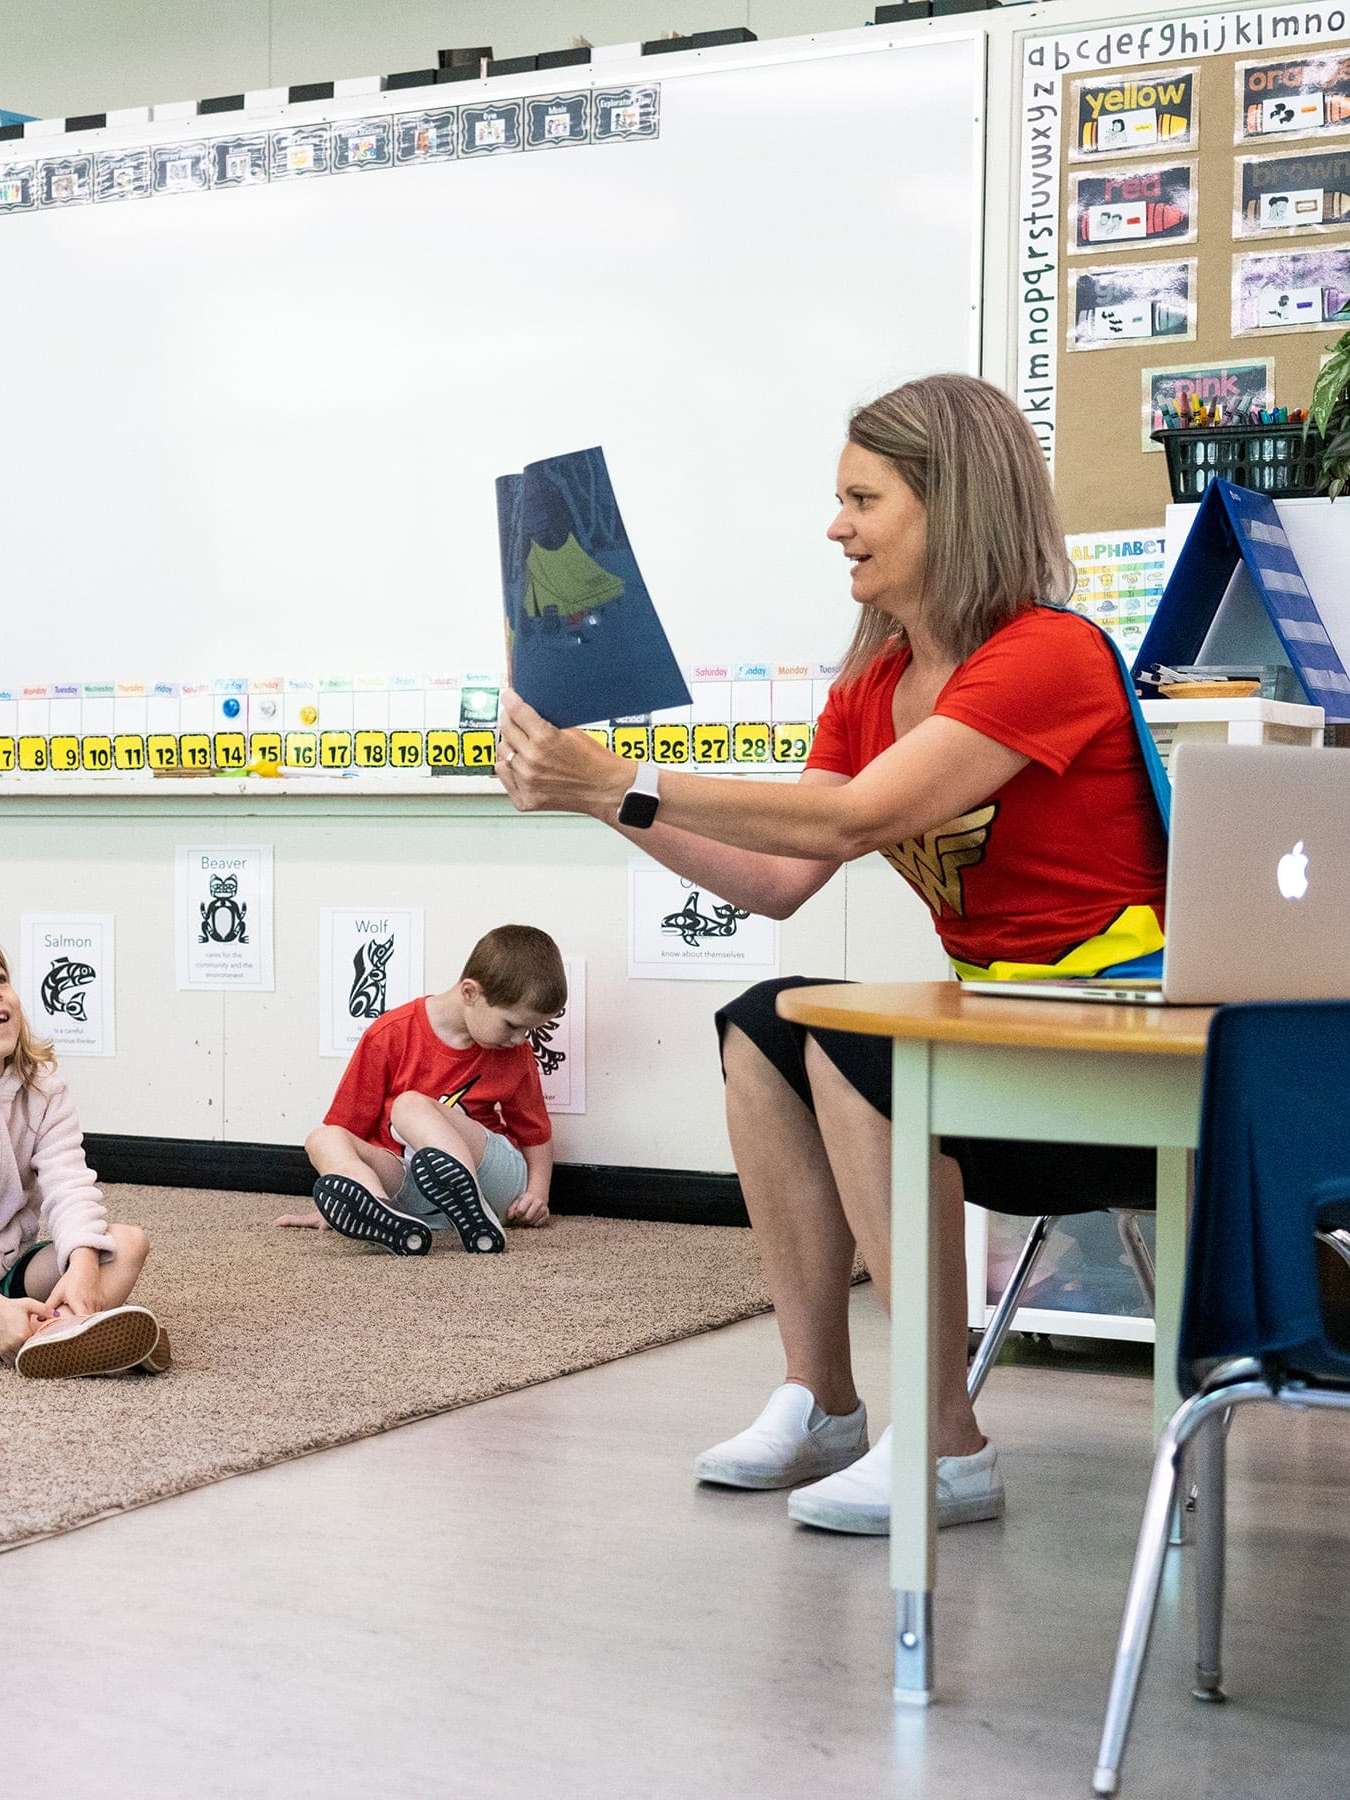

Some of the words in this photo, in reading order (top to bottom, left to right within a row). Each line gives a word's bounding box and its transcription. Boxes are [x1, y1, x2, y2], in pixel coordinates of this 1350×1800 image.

[1085, 83, 1186, 119] yellow
[1105, 171, 1161, 202] red
[1174, 369, 1240, 400] pink
[1071, 538, 1166, 560] ALPHABET
[54, 686, 78, 694] Tuesday
[154, 684, 173, 694] Friday
[695, 667, 728, 678] Saturday
[738, 666, 766, 677] Snday
[777, 664, 808, 675] Monday
[819, 664, 841, 674] Tues
[2, 750, 12, 766] 7
[34, 749, 44, 766] 8
[66, 749, 76, 766] 9
[90, 749, 108, 766] 10
[125, 749, 140, 765] 11
[156, 748, 174, 765] 12
[188, 747, 207, 764] 13
[222, 746, 242, 764] 14
[259, 746, 278, 762] 15
[294, 746, 312, 764] 16
[328, 745, 348, 763] 17
[363, 745, 383, 763] 18
[398, 745, 419, 763] 19
[432, 744, 456, 762] 20
[472, 744, 492, 763] 21
[620, 740, 645, 759] 25
[660, 739, 684, 759] 26
[700, 739, 725, 758] 27
[742, 738, 766, 757] 28
[780, 738, 808, 757] 29
[200, 856, 247, 870] Beaver
[355, 919, 388, 934] Wolf
[44, 934, 92, 948] Salmon
[661, 950, 680, 958] know
[682, 950, 703, 958] about
[704, 951, 745, 959] themselves
